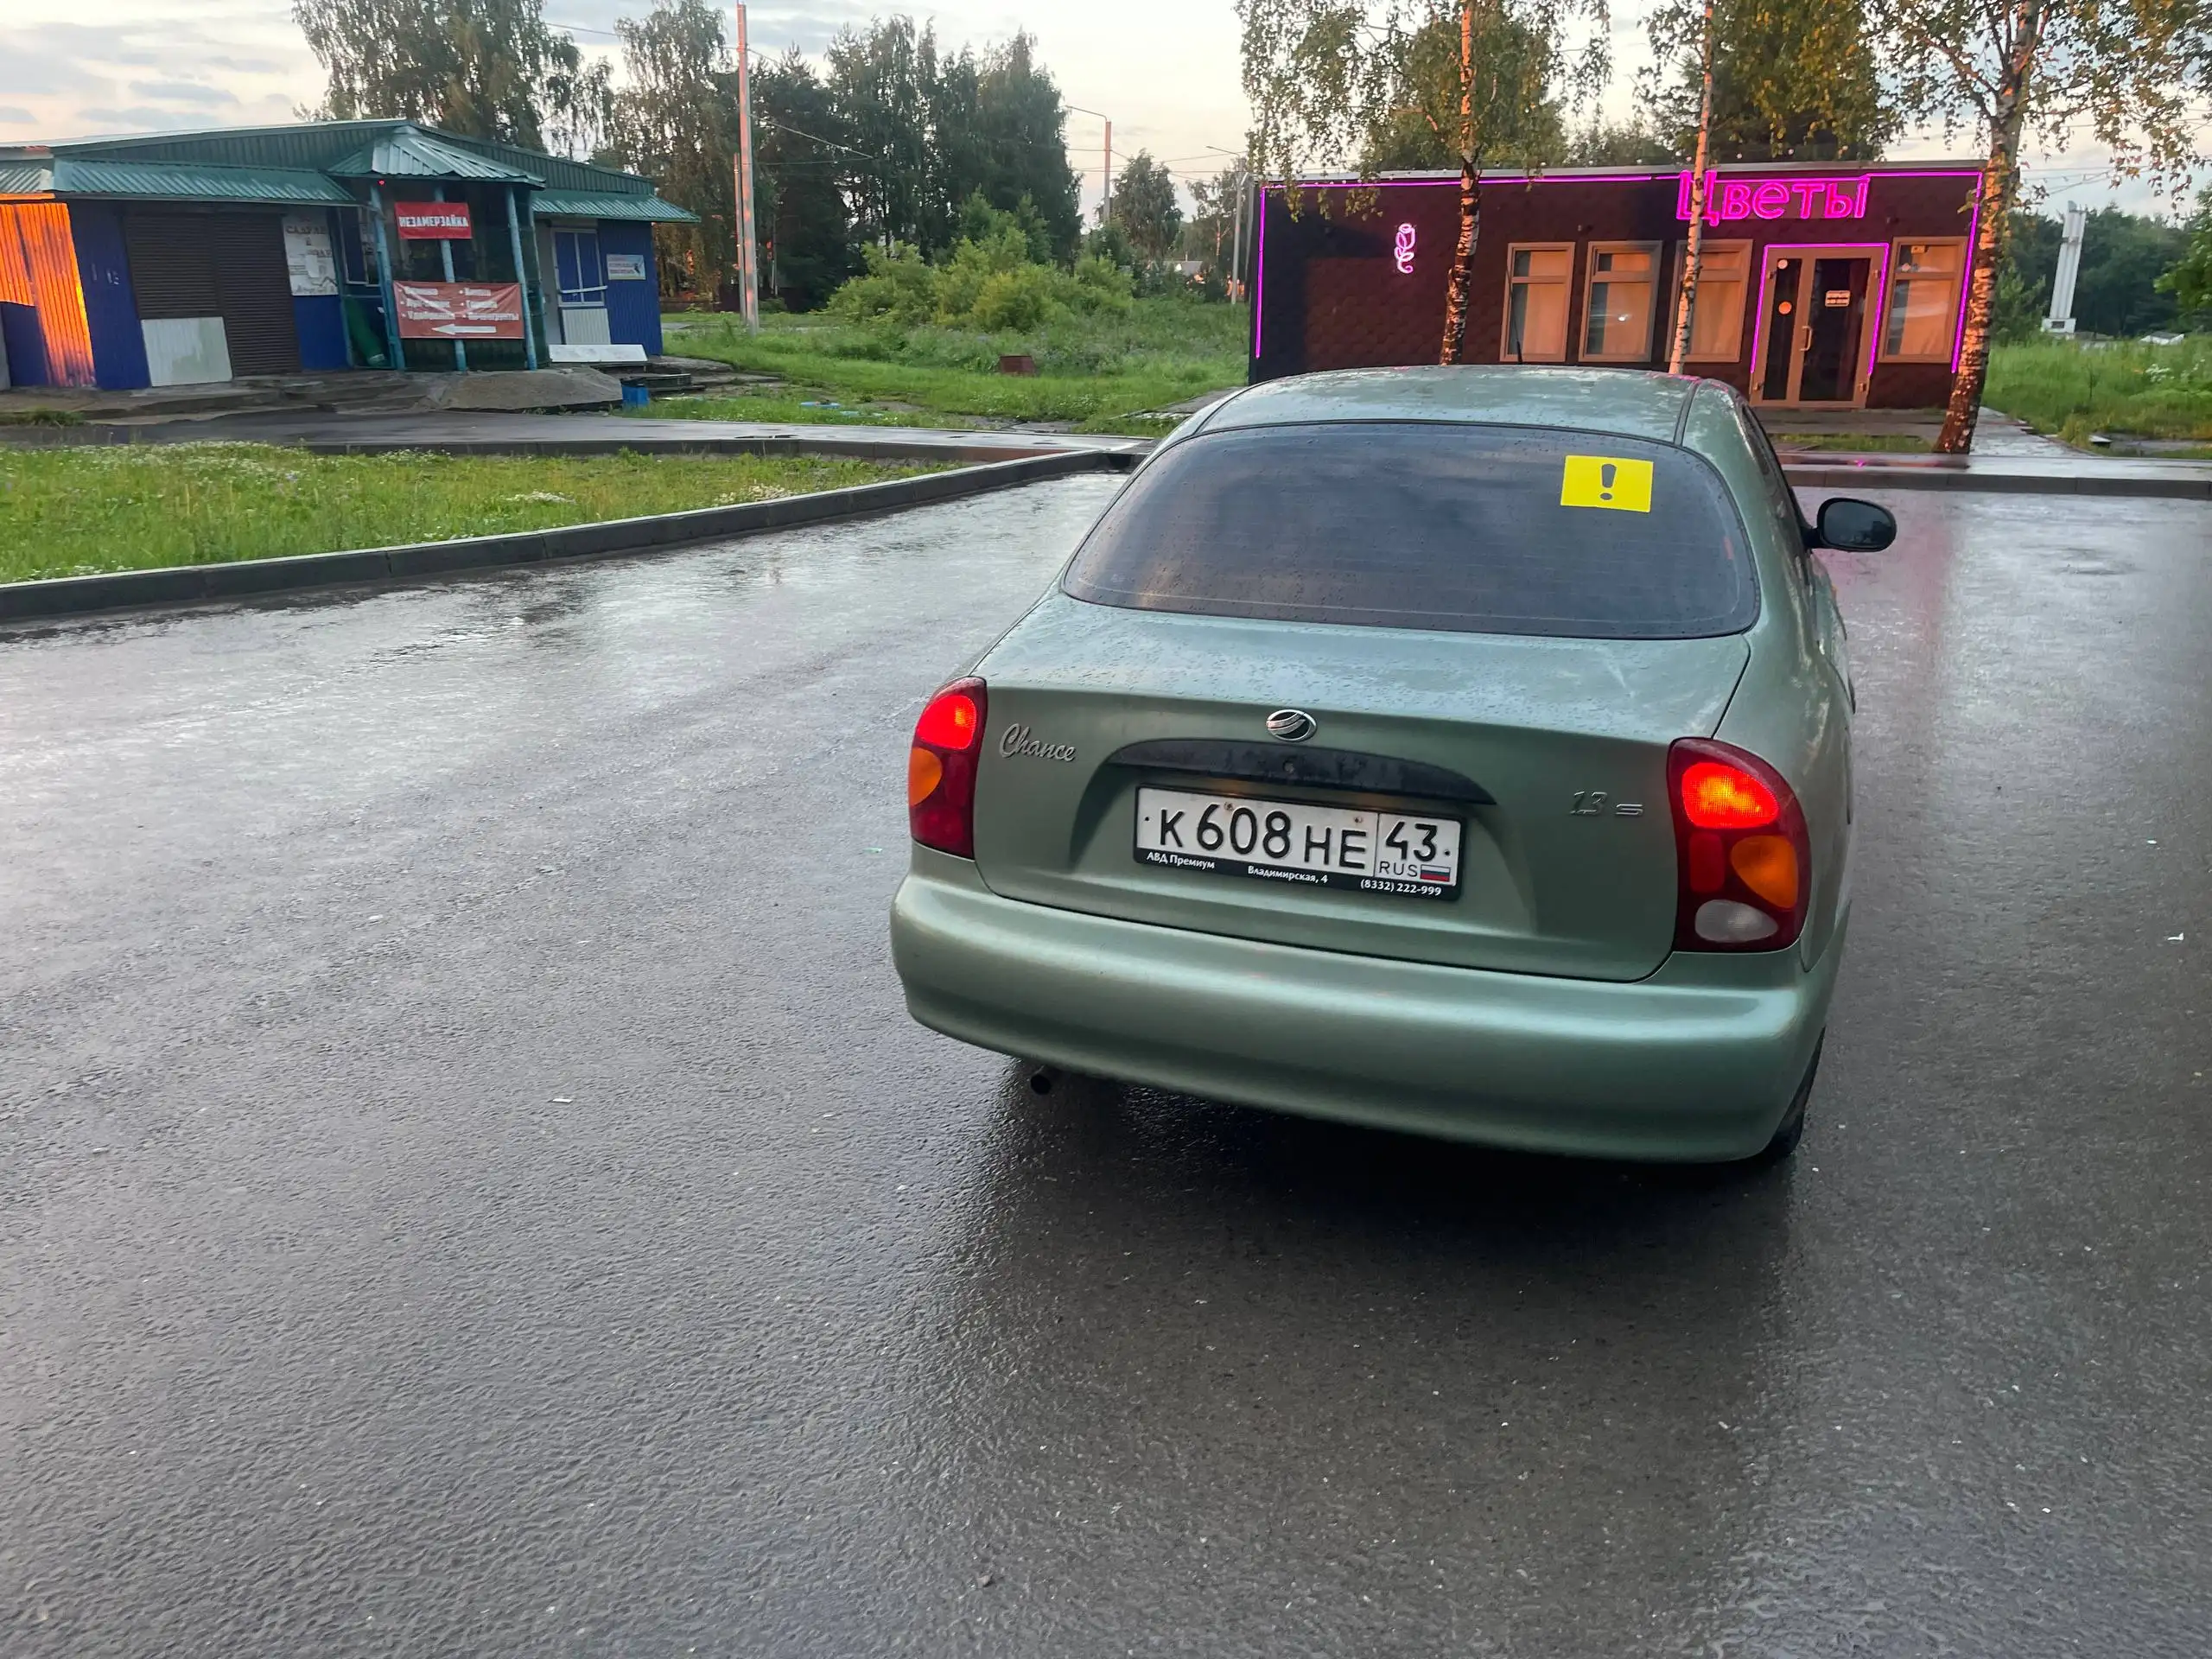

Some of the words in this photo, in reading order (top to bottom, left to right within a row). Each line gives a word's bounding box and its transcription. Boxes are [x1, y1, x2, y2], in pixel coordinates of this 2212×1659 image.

[1676, 169, 1871, 226] Цветы
[398, 214, 469, 227] НЕЗАМЕРЗАЙКА
[999, 722, 1077, 762] Chance
[1385, 821, 1436, 862] 43
[1147, 851, 1168, 865] АВД
[1169, 855, 1215, 870] Премиум
[1379, 861, 1418, 877] RUS
[1248, 865, 1319, 884] Владимирская,
[1320, 874, 1328, 883] 4
[1360, 879, 1395, 893] (8332)
[1396, 882, 1442, 896] 222-999
